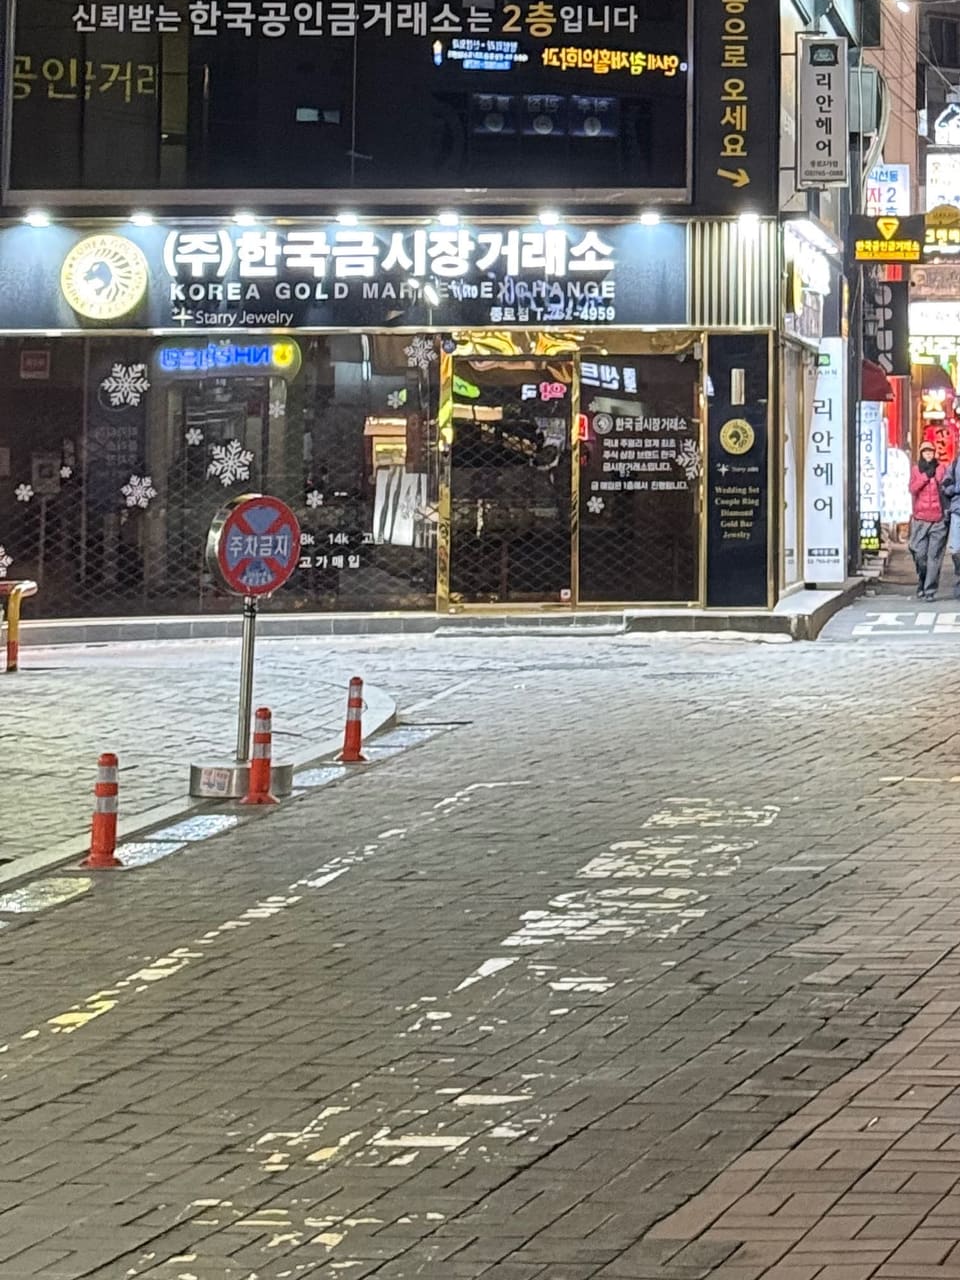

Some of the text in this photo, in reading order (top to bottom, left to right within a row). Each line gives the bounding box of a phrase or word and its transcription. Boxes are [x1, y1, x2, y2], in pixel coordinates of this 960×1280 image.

[72, 1, 638, 37] 신뢰받는 한국공인금거래소는 2층입니다
[720, 78, 748, 157] 오세요
[815, 72, 834, 158] 리안헤어
[163, 230, 616, 277] (주)한국금시장거래소
[170, 282, 261, 301] KOREA
[275, 283, 358, 301] GOLD
[196, 309, 294, 327] Starry Jewelry
[615, 416, 687, 432] 한국금시장거래소
[812, 397, 834, 521] 리안헤어
[229, 534, 288, 557] 주차금지
[297, 532, 315, 545] 8k
[328, 532, 350, 545] 14k
[299, 554, 361, 569] 고가매입
